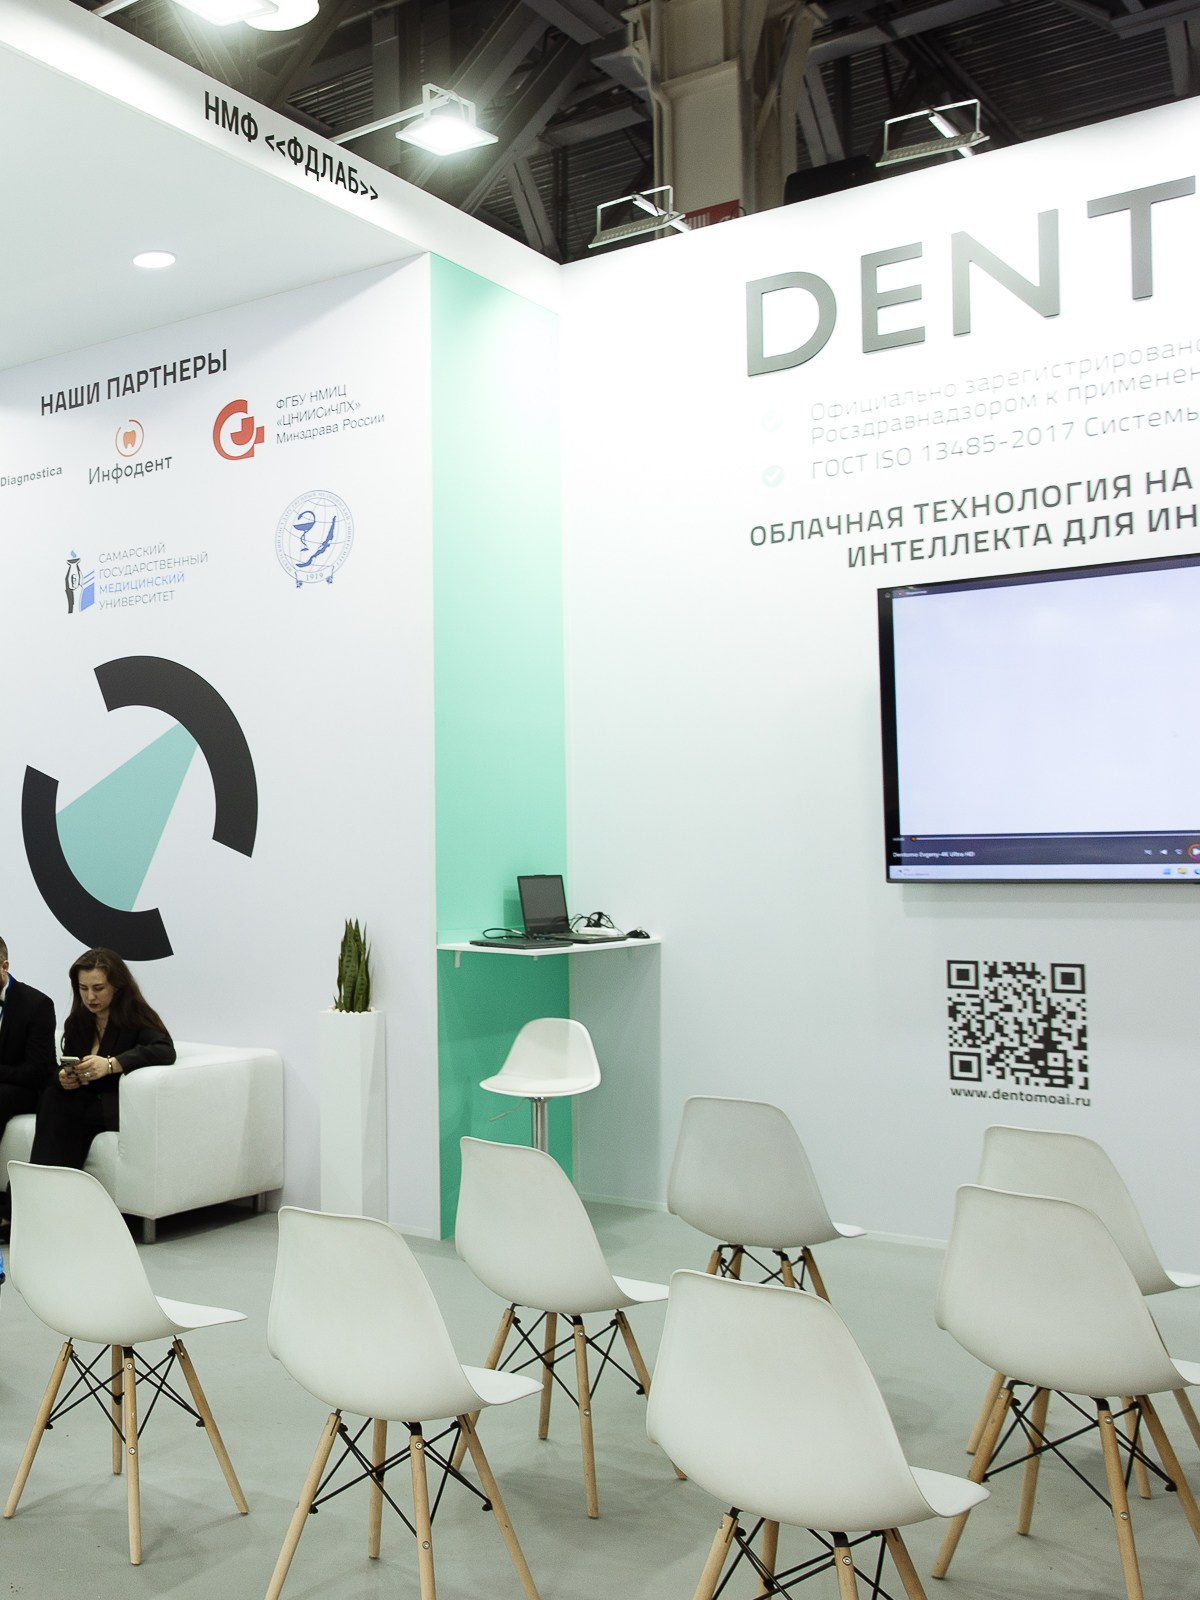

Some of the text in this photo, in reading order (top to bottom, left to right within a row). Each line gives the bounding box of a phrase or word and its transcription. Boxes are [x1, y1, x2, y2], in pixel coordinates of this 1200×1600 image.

[204, 90, 259, 143] НМФ
[745, 175, 1196, 378] DENT
[40, 348, 228, 417] НАШИ ПАРТНЕРЫ
[275, 383, 348, 410] ФГБУ НМИЦ
[810, 382, 958, 422] Официально
[810, 393, 1038, 446] Росздравнадзором
[1045, 389, 1060, 406] к
[276, 413, 385, 445] Минздрава России
[812, 452, 869, 480] ГОСТ
[875, 446, 913, 470] ISO
[921, 420, 1075, 463] 13485-2017
[0, 466, 64, 488] Diagnostica
[87, 455, 173, 486] Инфодент
[749, 466, 1194, 547] ОБЛАЧНАЯ ТЕХНОЛОГИЯ НА
[98, 542, 167, 564] САМАРСКИЙ
[847, 522, 1053, 569] ИНТЕЛЛЕКТА
[1062, 511, 1134, 547] ДЛЯ
[98, 551, 209, 580] ГОСУДАРСТВЕННЫЙ
[98, 571, 186, 595] МЕДИЦИНСКИЙ
[98, 589, 176, 611] УНИВЕРСИТЕТ
[950, 1086, 1091, 1107] www.dentomoai.ru
